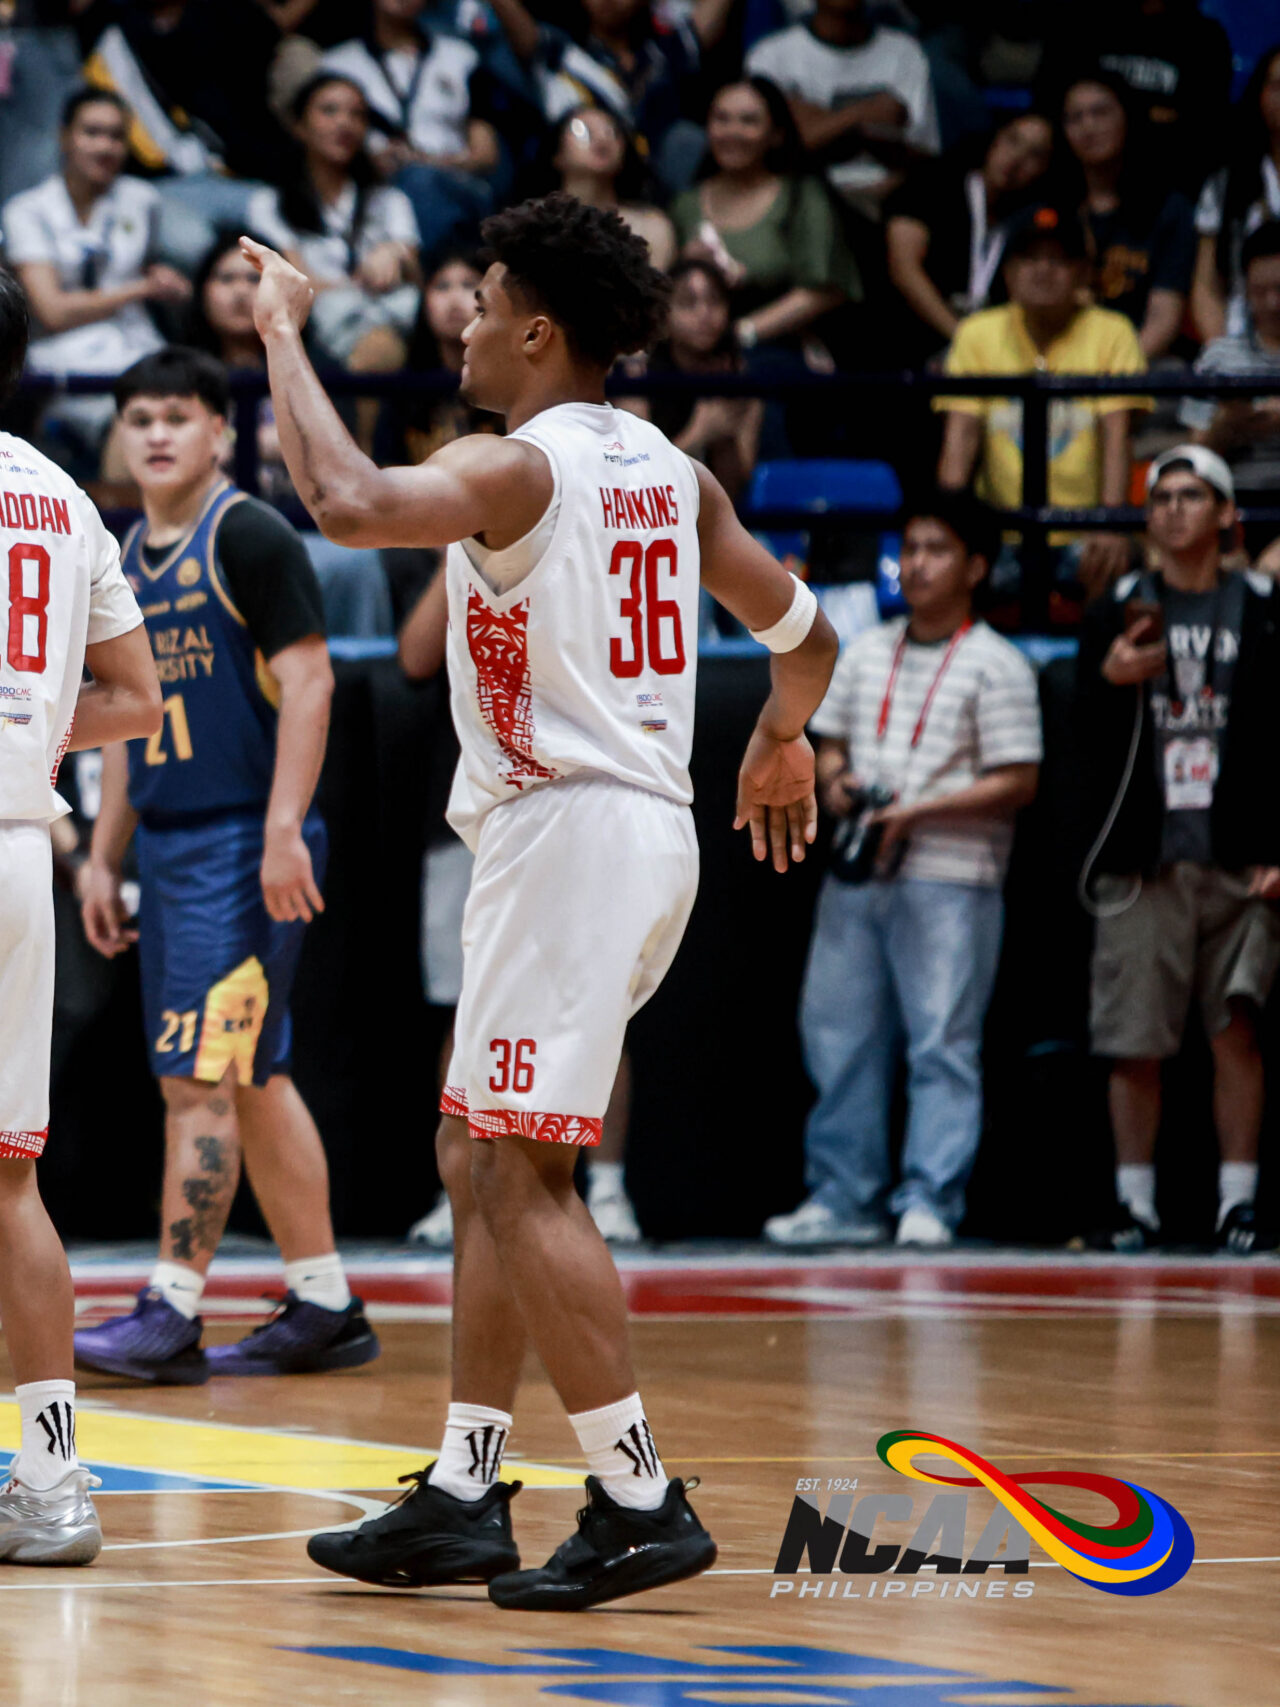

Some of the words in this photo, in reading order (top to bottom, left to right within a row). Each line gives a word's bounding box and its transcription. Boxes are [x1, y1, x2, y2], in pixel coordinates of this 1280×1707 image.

[609, 538, 686, 678] 36
[156, 1009, 198, 1053] 21
[489, 1038, 537, 1094] 36
